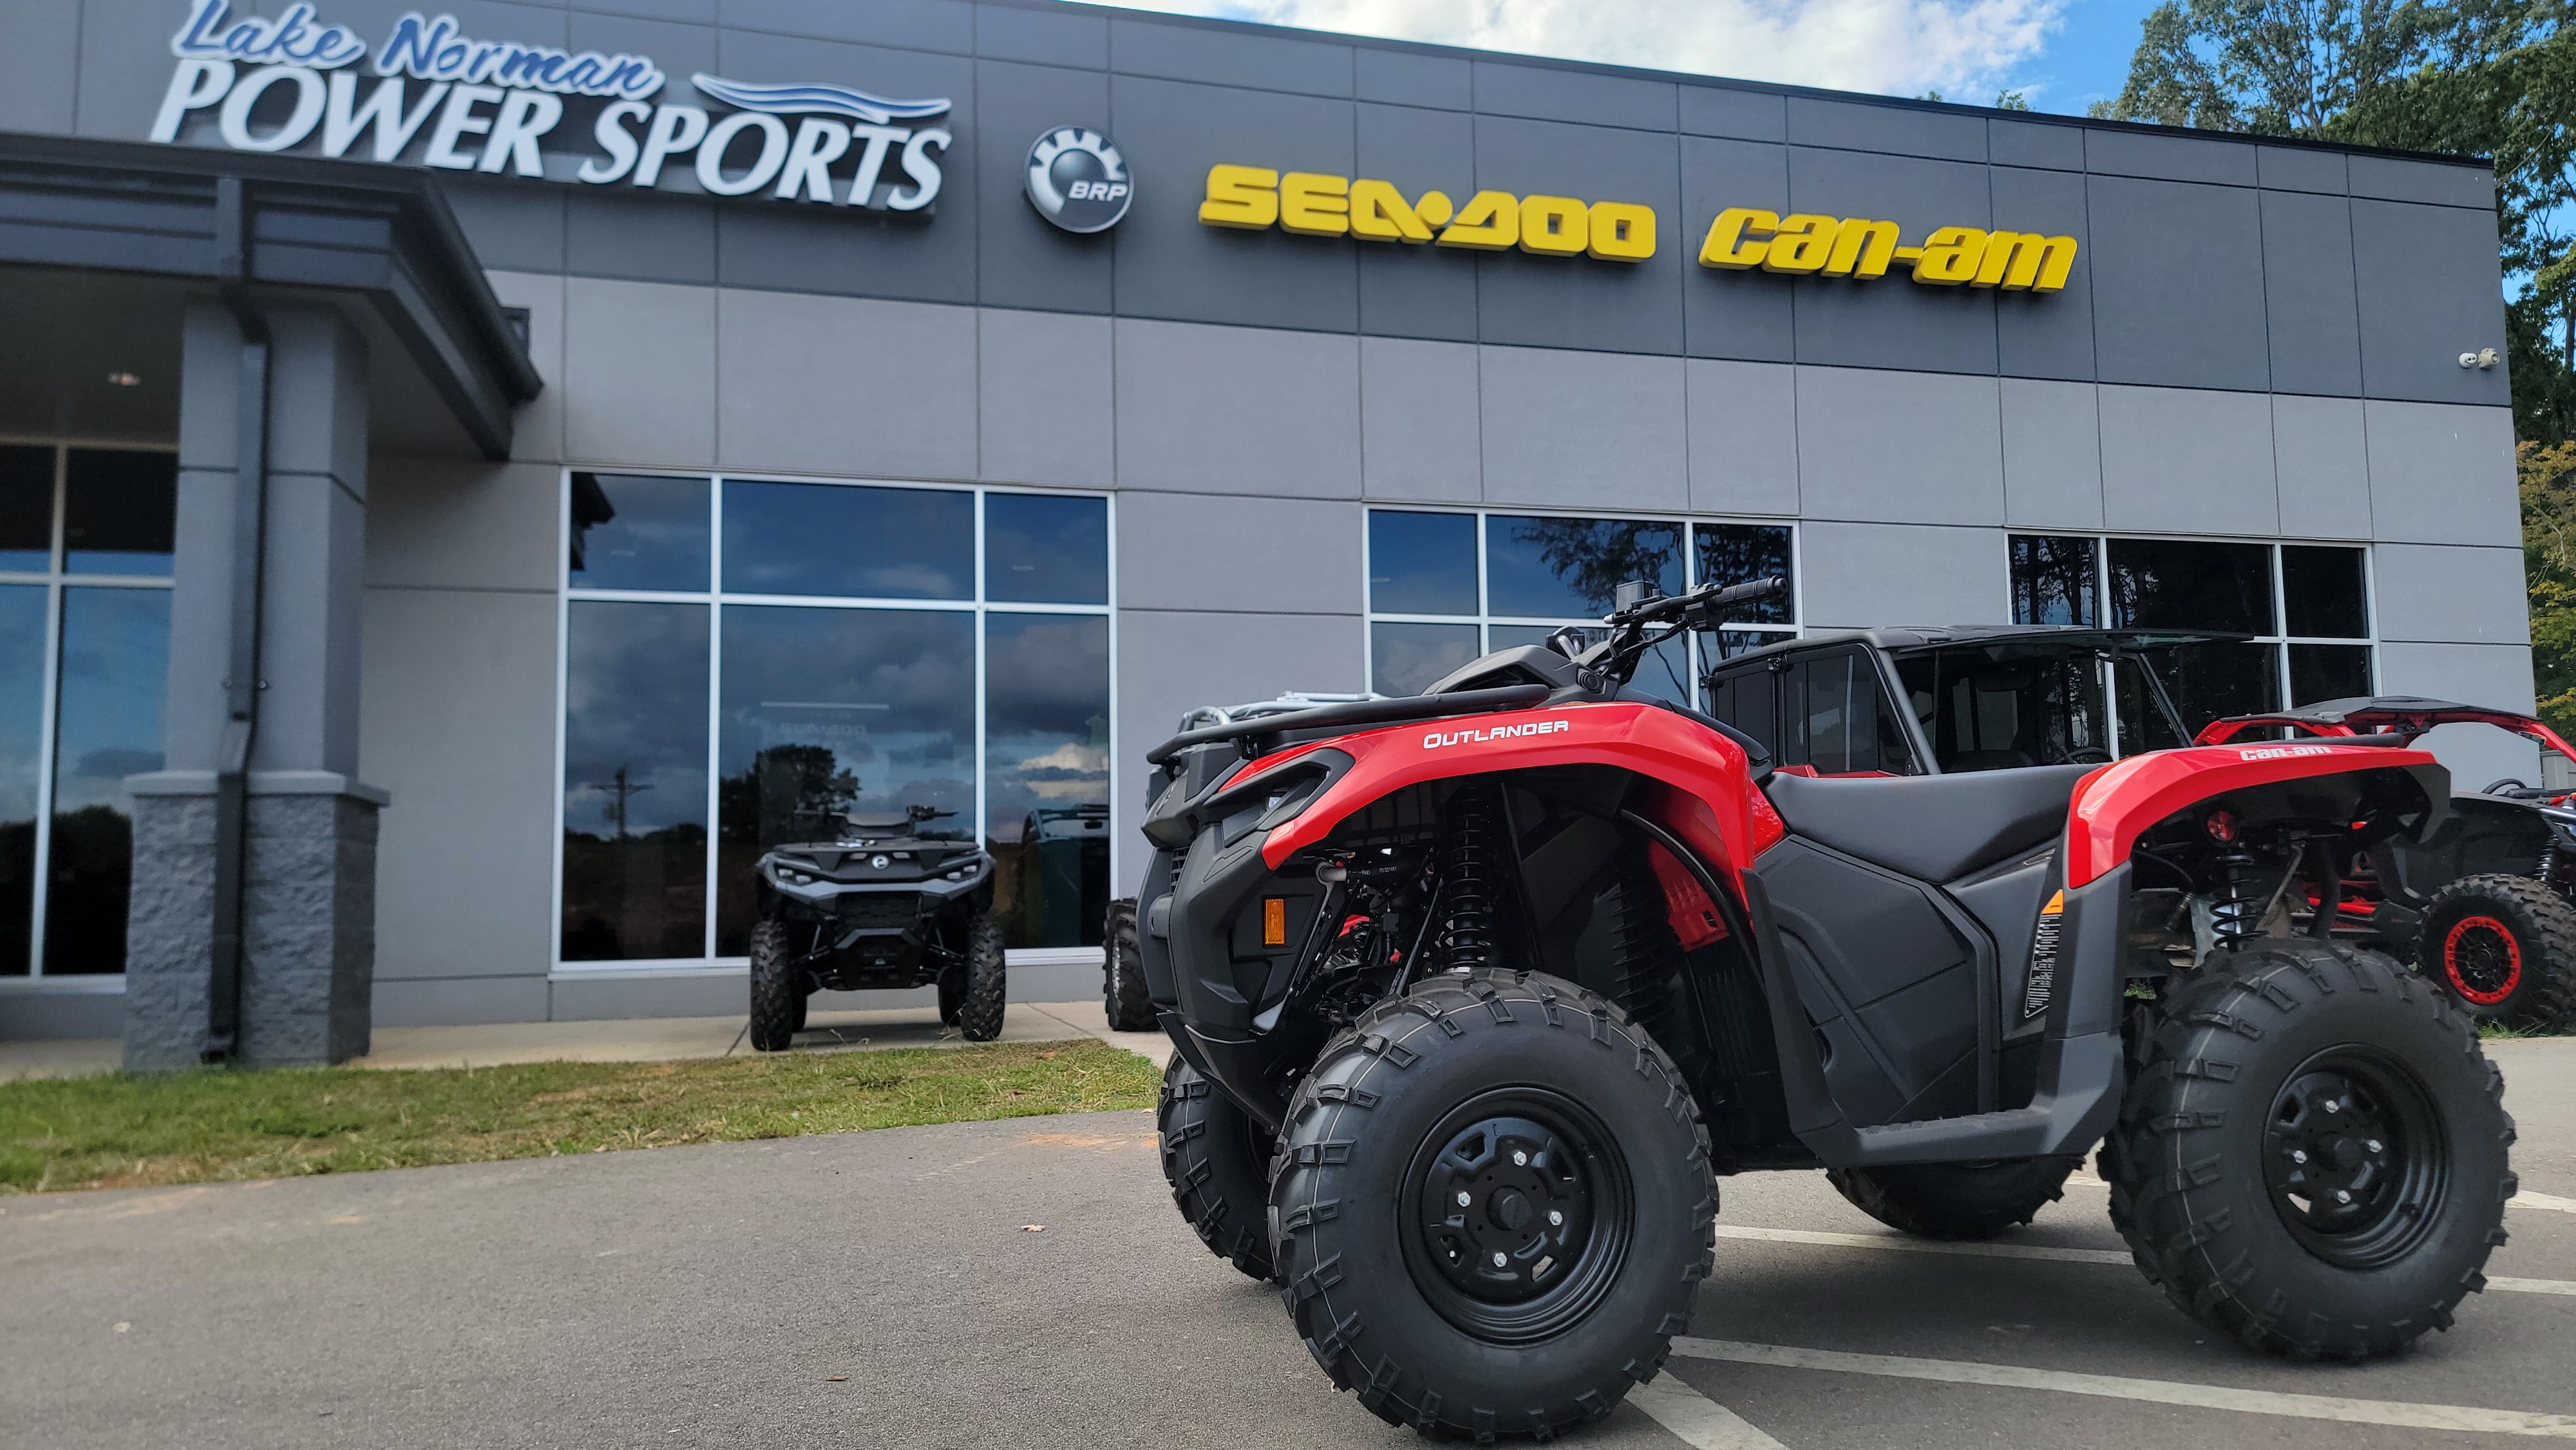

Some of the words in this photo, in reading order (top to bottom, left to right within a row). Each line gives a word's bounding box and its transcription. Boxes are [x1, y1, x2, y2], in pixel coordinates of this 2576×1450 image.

[173, 0, 365, 67] Lake
[375, 12, 665, 99] Norman
[148, 59, 564, 178] POWER
[576, 100, 953, 211] SPORTS
[1068, 180, 1128, 202] BRP
[1423, 720, 1569, 749] OUTLANDER
